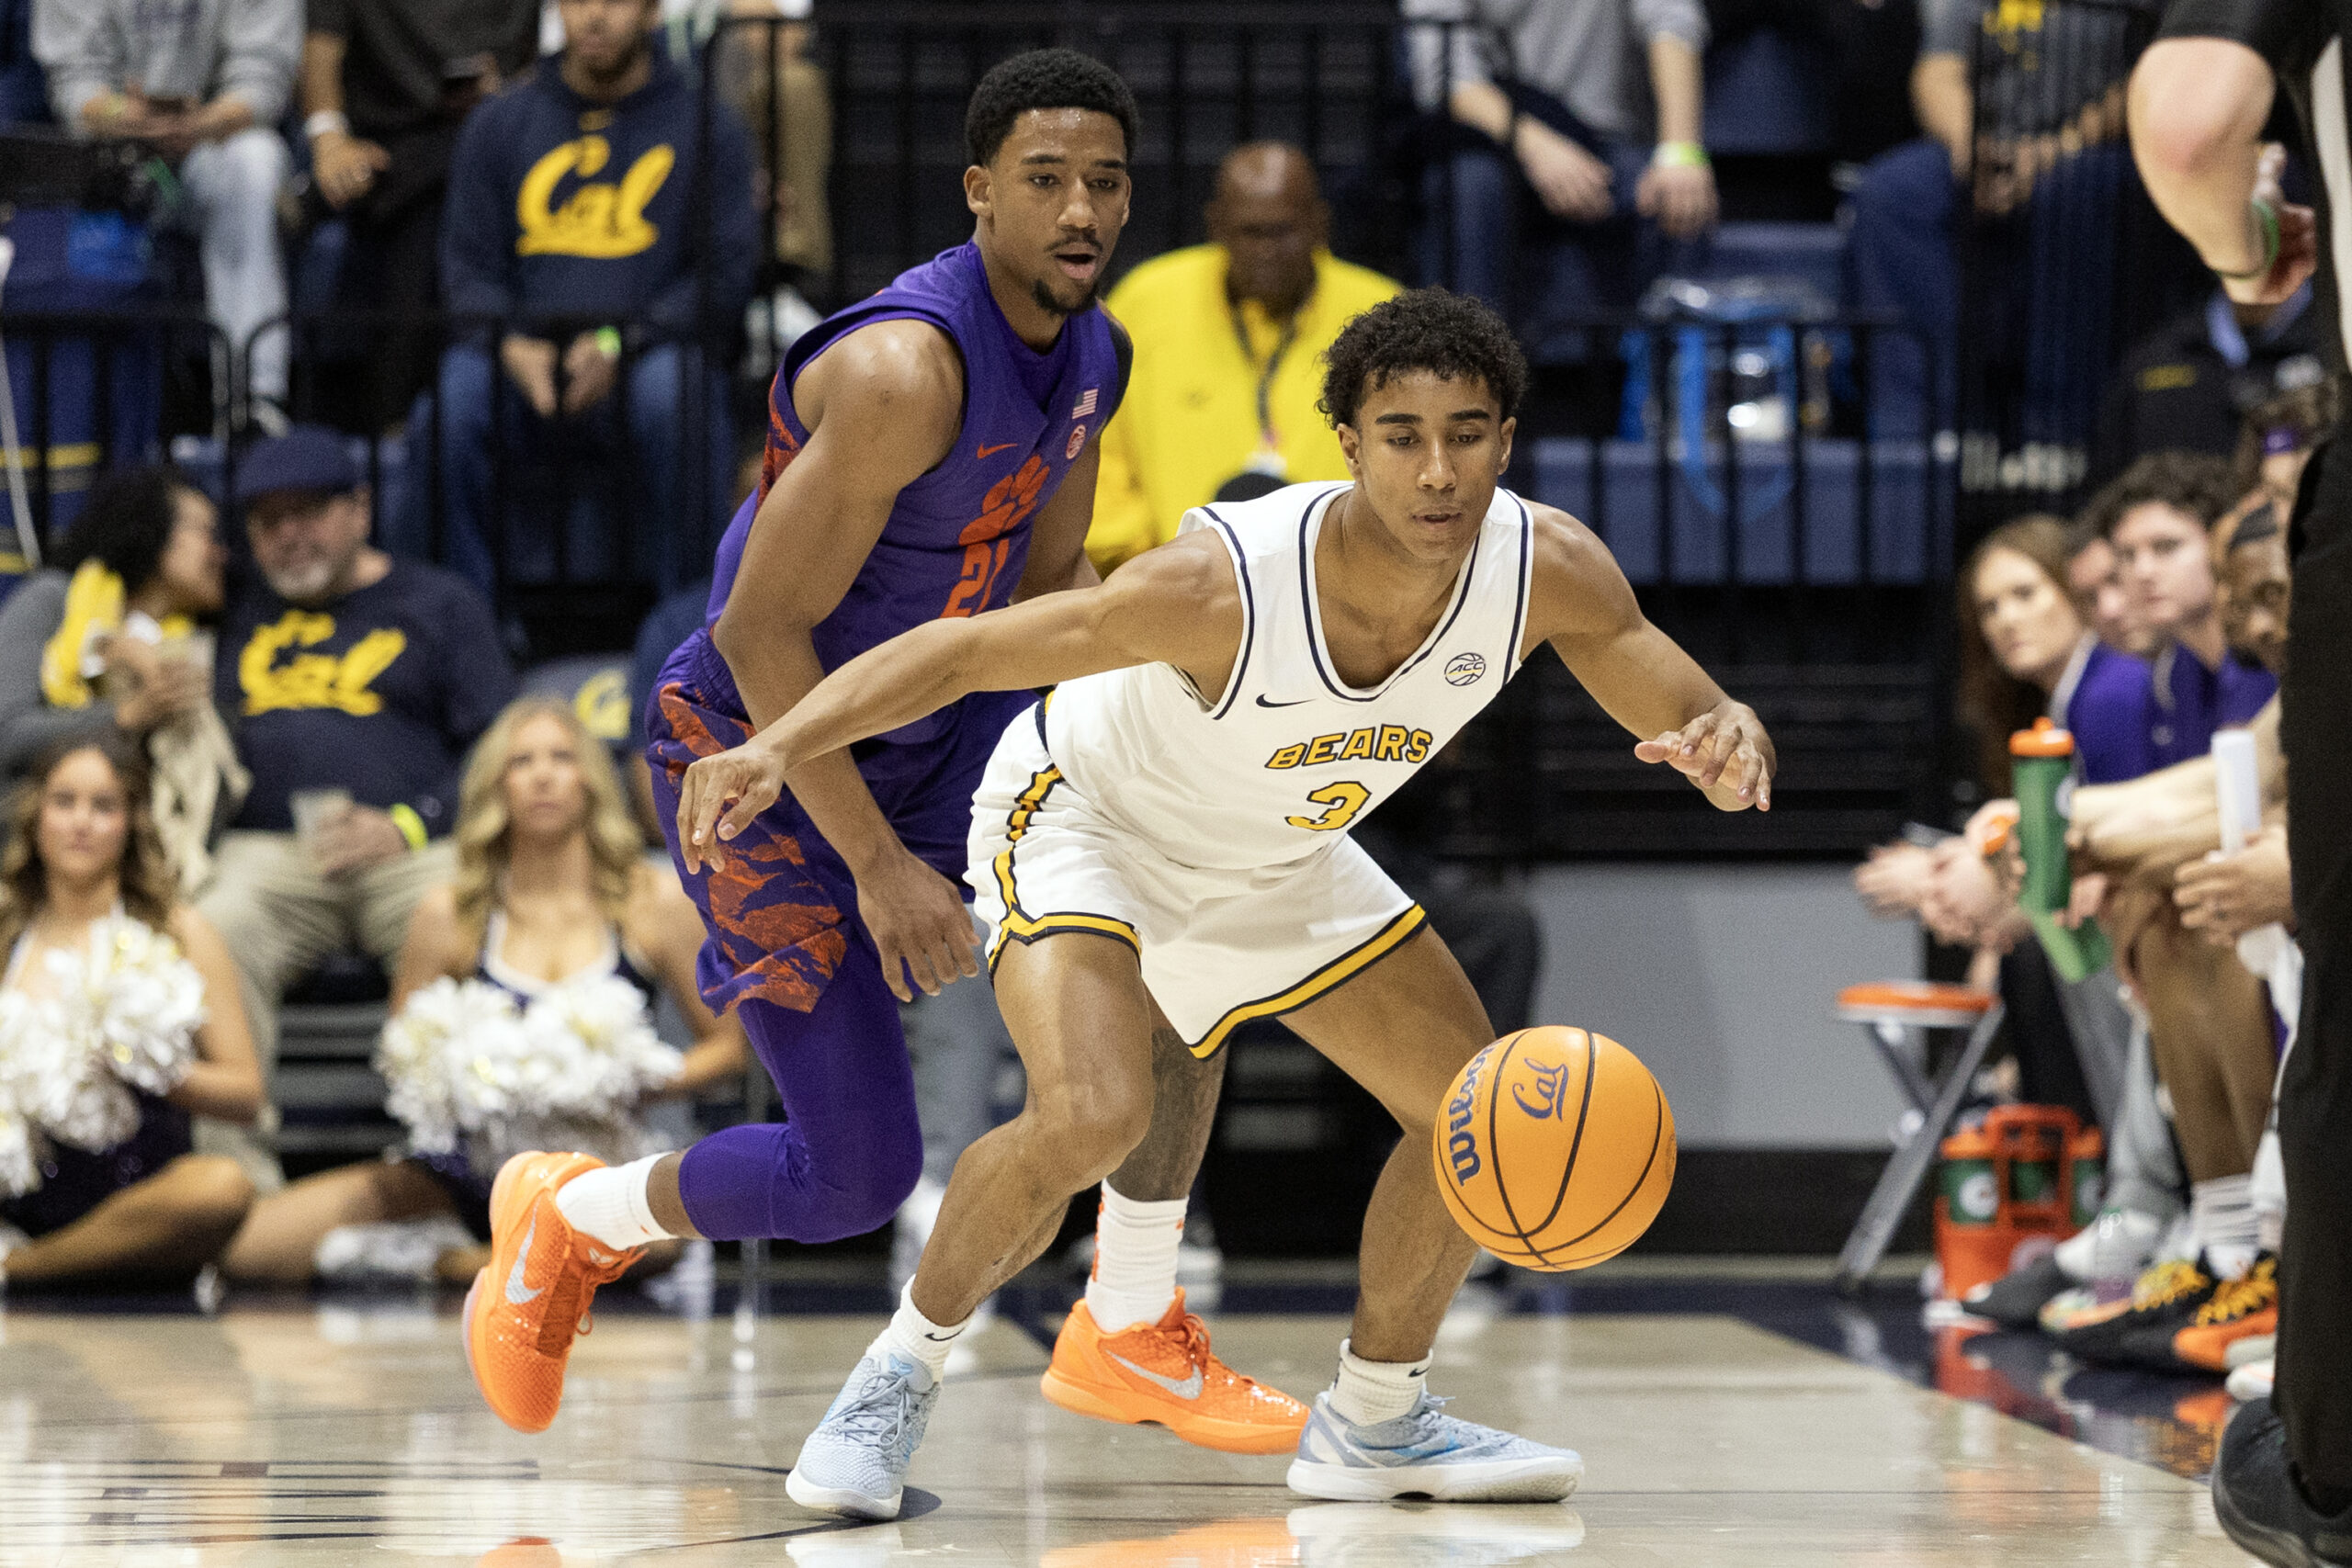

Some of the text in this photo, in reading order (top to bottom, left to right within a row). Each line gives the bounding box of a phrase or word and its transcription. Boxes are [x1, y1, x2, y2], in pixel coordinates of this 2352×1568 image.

[515, 134, 676, 260] Cal
[939, 538, 1010, 619] 21
[240, 609, 408, 717] Cal
[1447, 661, 1485, 674] ACC
[1264, 724, 1433, 770] BEARS
[1284, 781, 1372, 831] 3
[1511, 1057, 1568, 1122] Cal
